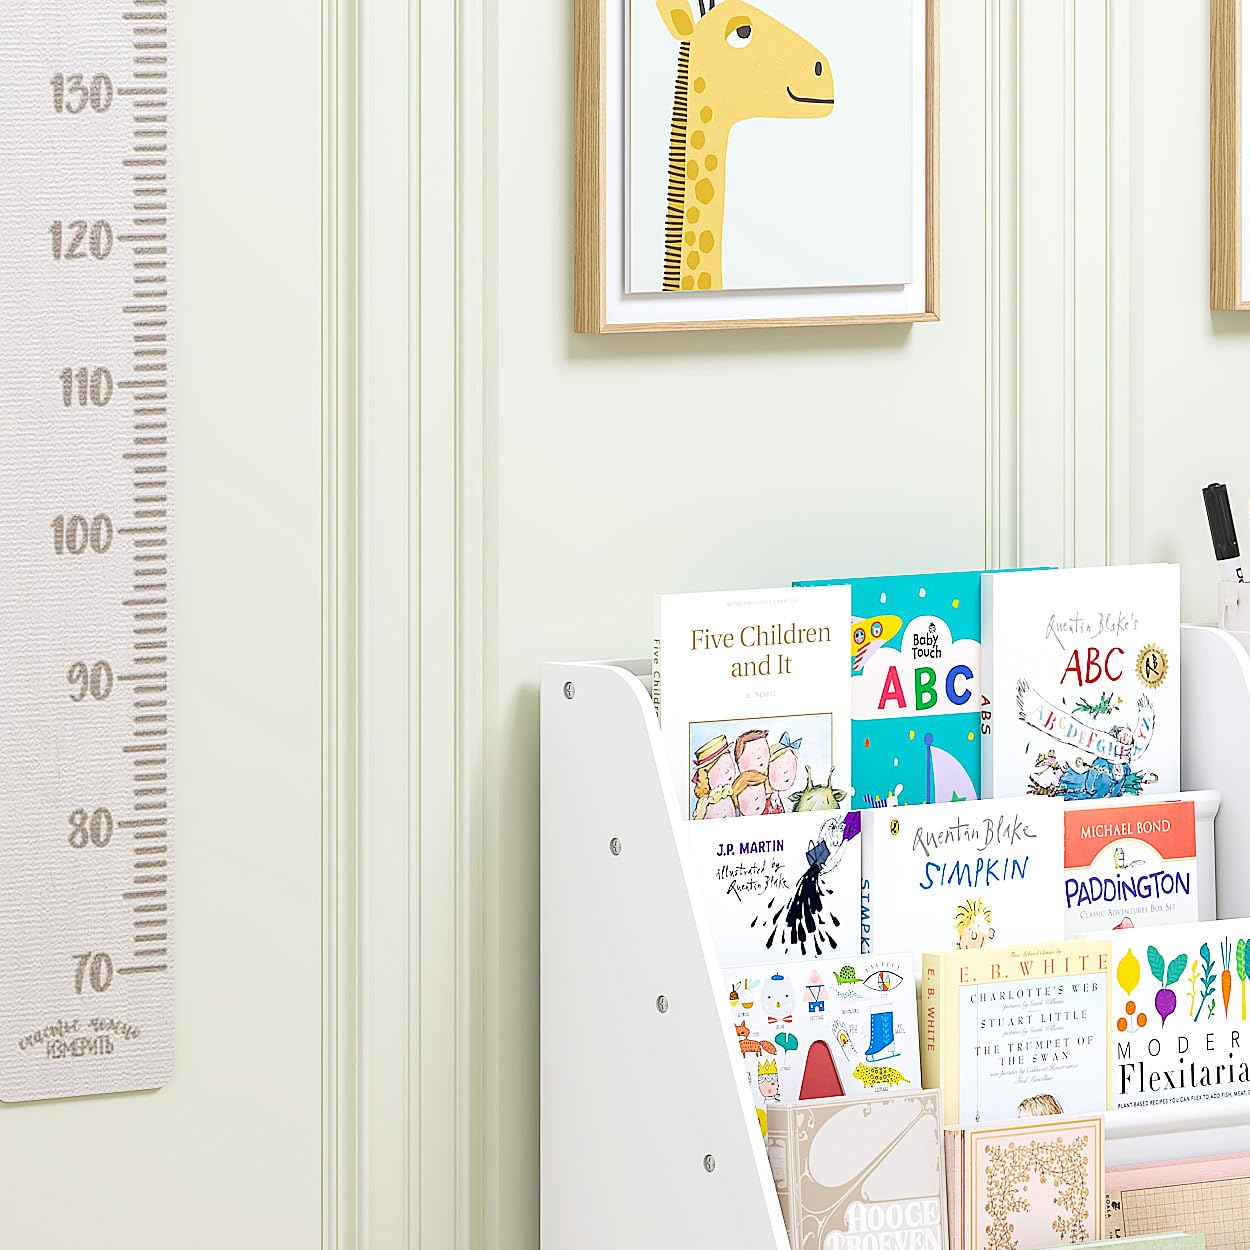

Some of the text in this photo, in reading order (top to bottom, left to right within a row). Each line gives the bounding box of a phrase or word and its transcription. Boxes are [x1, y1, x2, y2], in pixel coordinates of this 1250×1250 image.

[51, 74, 113, 112] 130
[49, 220, 113, 260] 120
[59, 366, 113, 406] 110
[51, 514, 113, 554] 100
[690, 623, 831, 650] Five Children
[913, 633, 938, 647] Baby
[1045, 611, 1139, 650] Quentin Blake's
[653, 640, 661, 665] Five
[731, 654, 792, 678] and It
[912, 647, 941, 659] Touch
[1060, 647, 1125, 687] ABC
[68, 662, 113, 702] 90
[878, 664, 974, 711] ABC
[68, 808, 113, 847] 80
[912, 813, 1038, 857] Quentin Blake
[1080, 819, 1171, 839] MICHAEL BOND
[716, 840, 784, 856] J.P. MARTIN
[919, 856, 1030, 890] SIMPKIN
[1065, 870, 1190, 908] PADDINGTON
[69, 952, 113, 994] 70
[960, 966, 976, 983] E.
[991, 964, 1008, 980] B.
[1019, 954, 1108, 976] WHITE
[927, 968, 935, 1051] E. B. WHITE
[970, 982, 1099, 1003] CHARLOTTE'S WEB
[980, 1009, 1088, 1029] STUART LITTLE
[974, 1035, 1094, 1056] THE TRUMPET OF
[1000, 1051, 1069, 1066] THE SWAN
[844, 1200, 940, 1233] HOOGE
